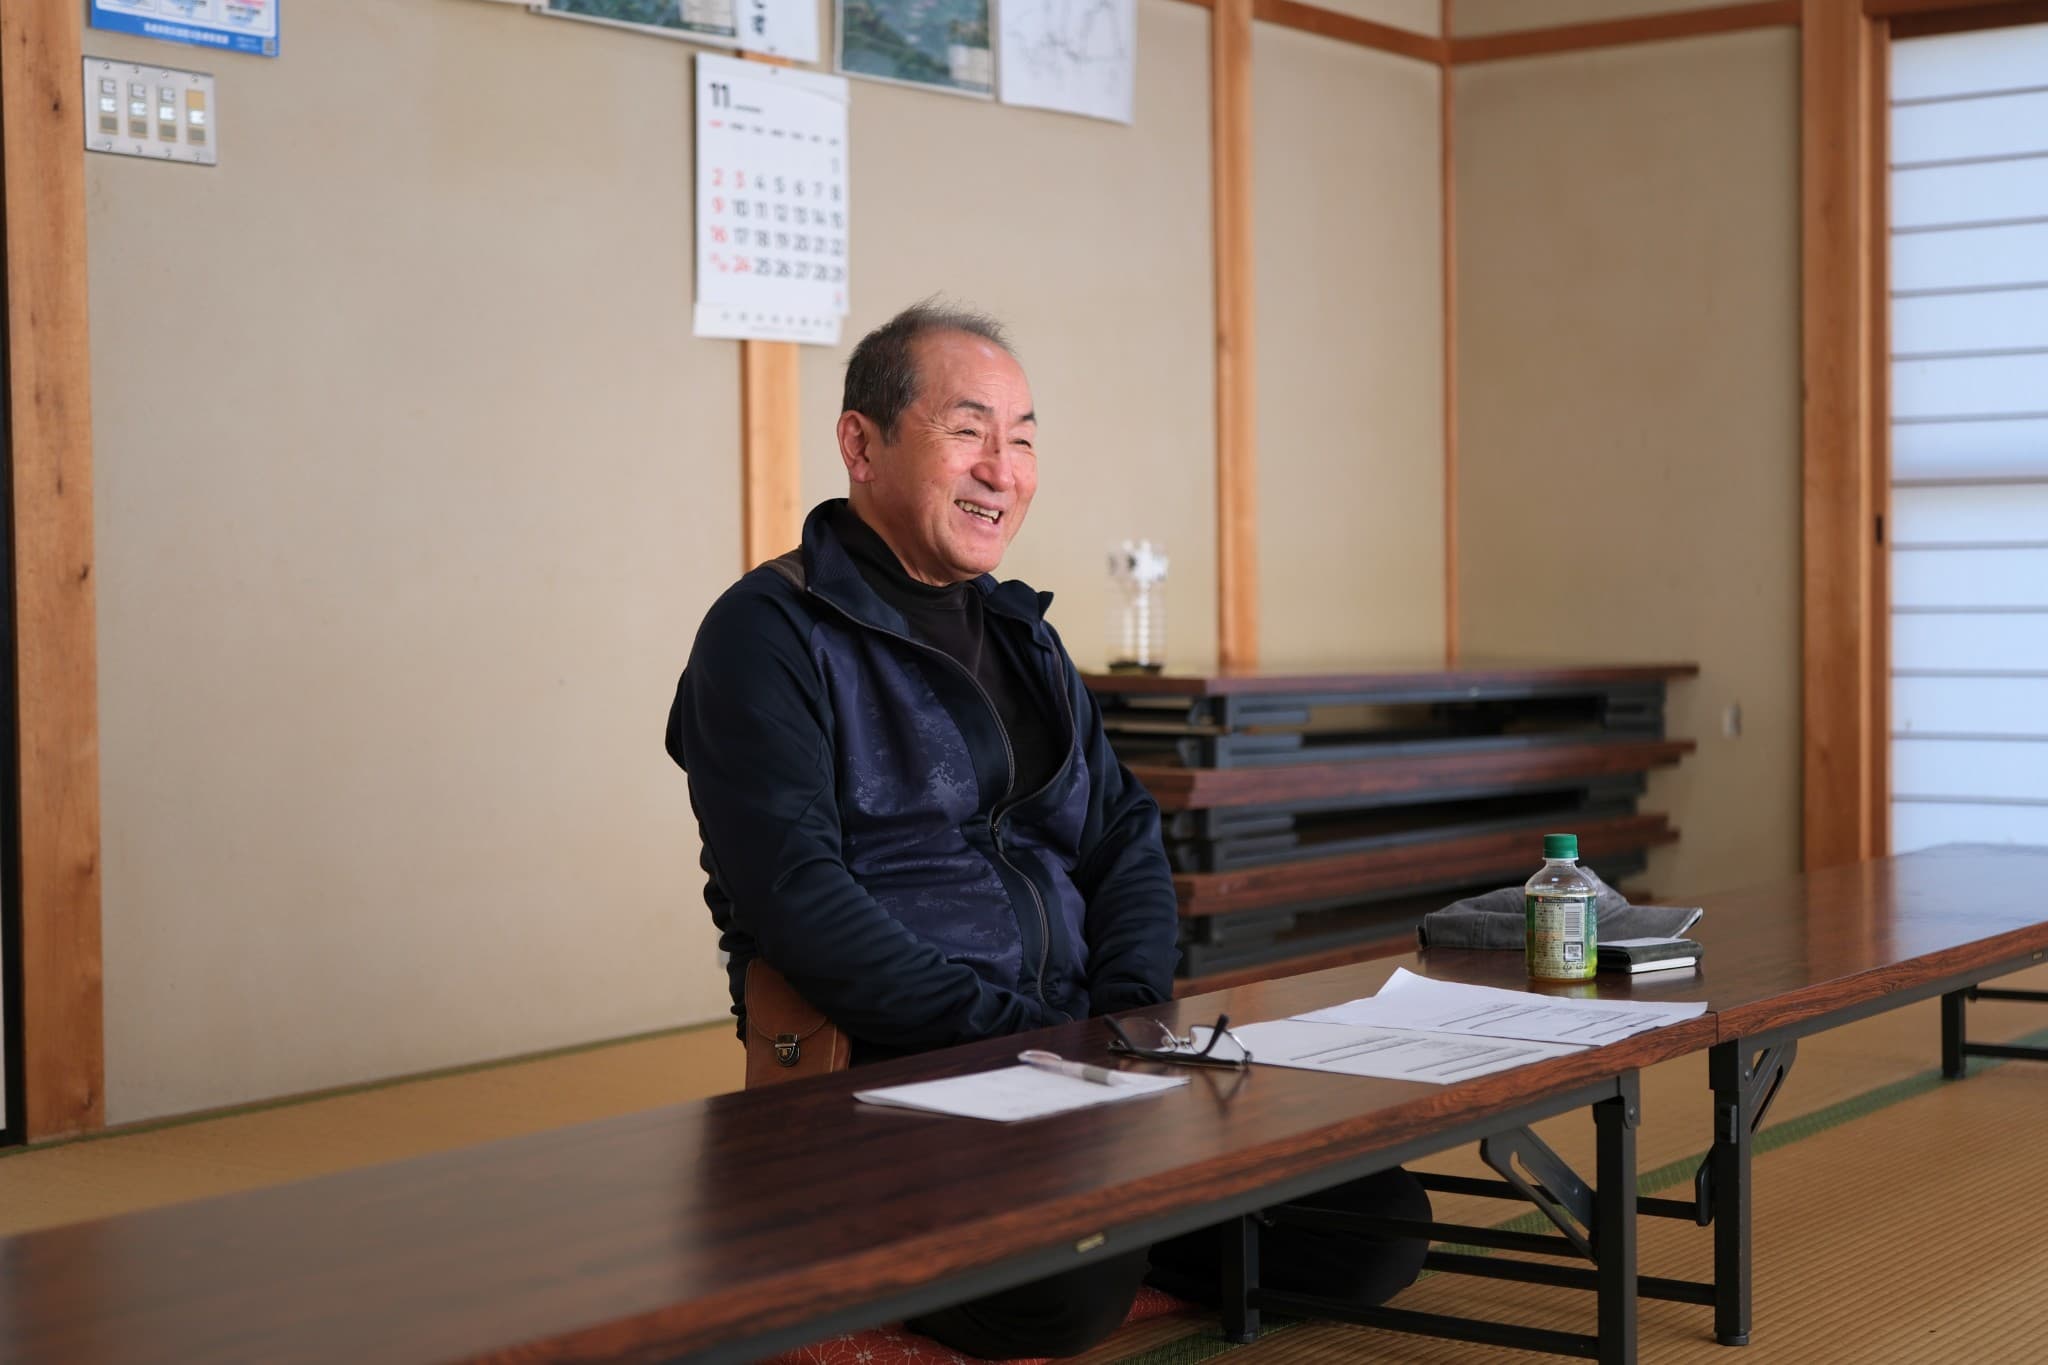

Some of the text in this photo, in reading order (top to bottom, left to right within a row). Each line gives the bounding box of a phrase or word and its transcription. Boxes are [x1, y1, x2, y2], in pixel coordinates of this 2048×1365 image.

[710, 82, 730, 108] 11
[712, 168, 723, 186] 2
[735, 170, 745, 188] 3
[774, 176, 786, 194] 5
[712, 196, 725, 213] 9
[732, 199, 748, 216] 10
[754, 201, 767, 218] 11
[710, 225, 728, 243] 16
[732, 227, 749, 245] 17
[754, 230, 770, 248] 18
